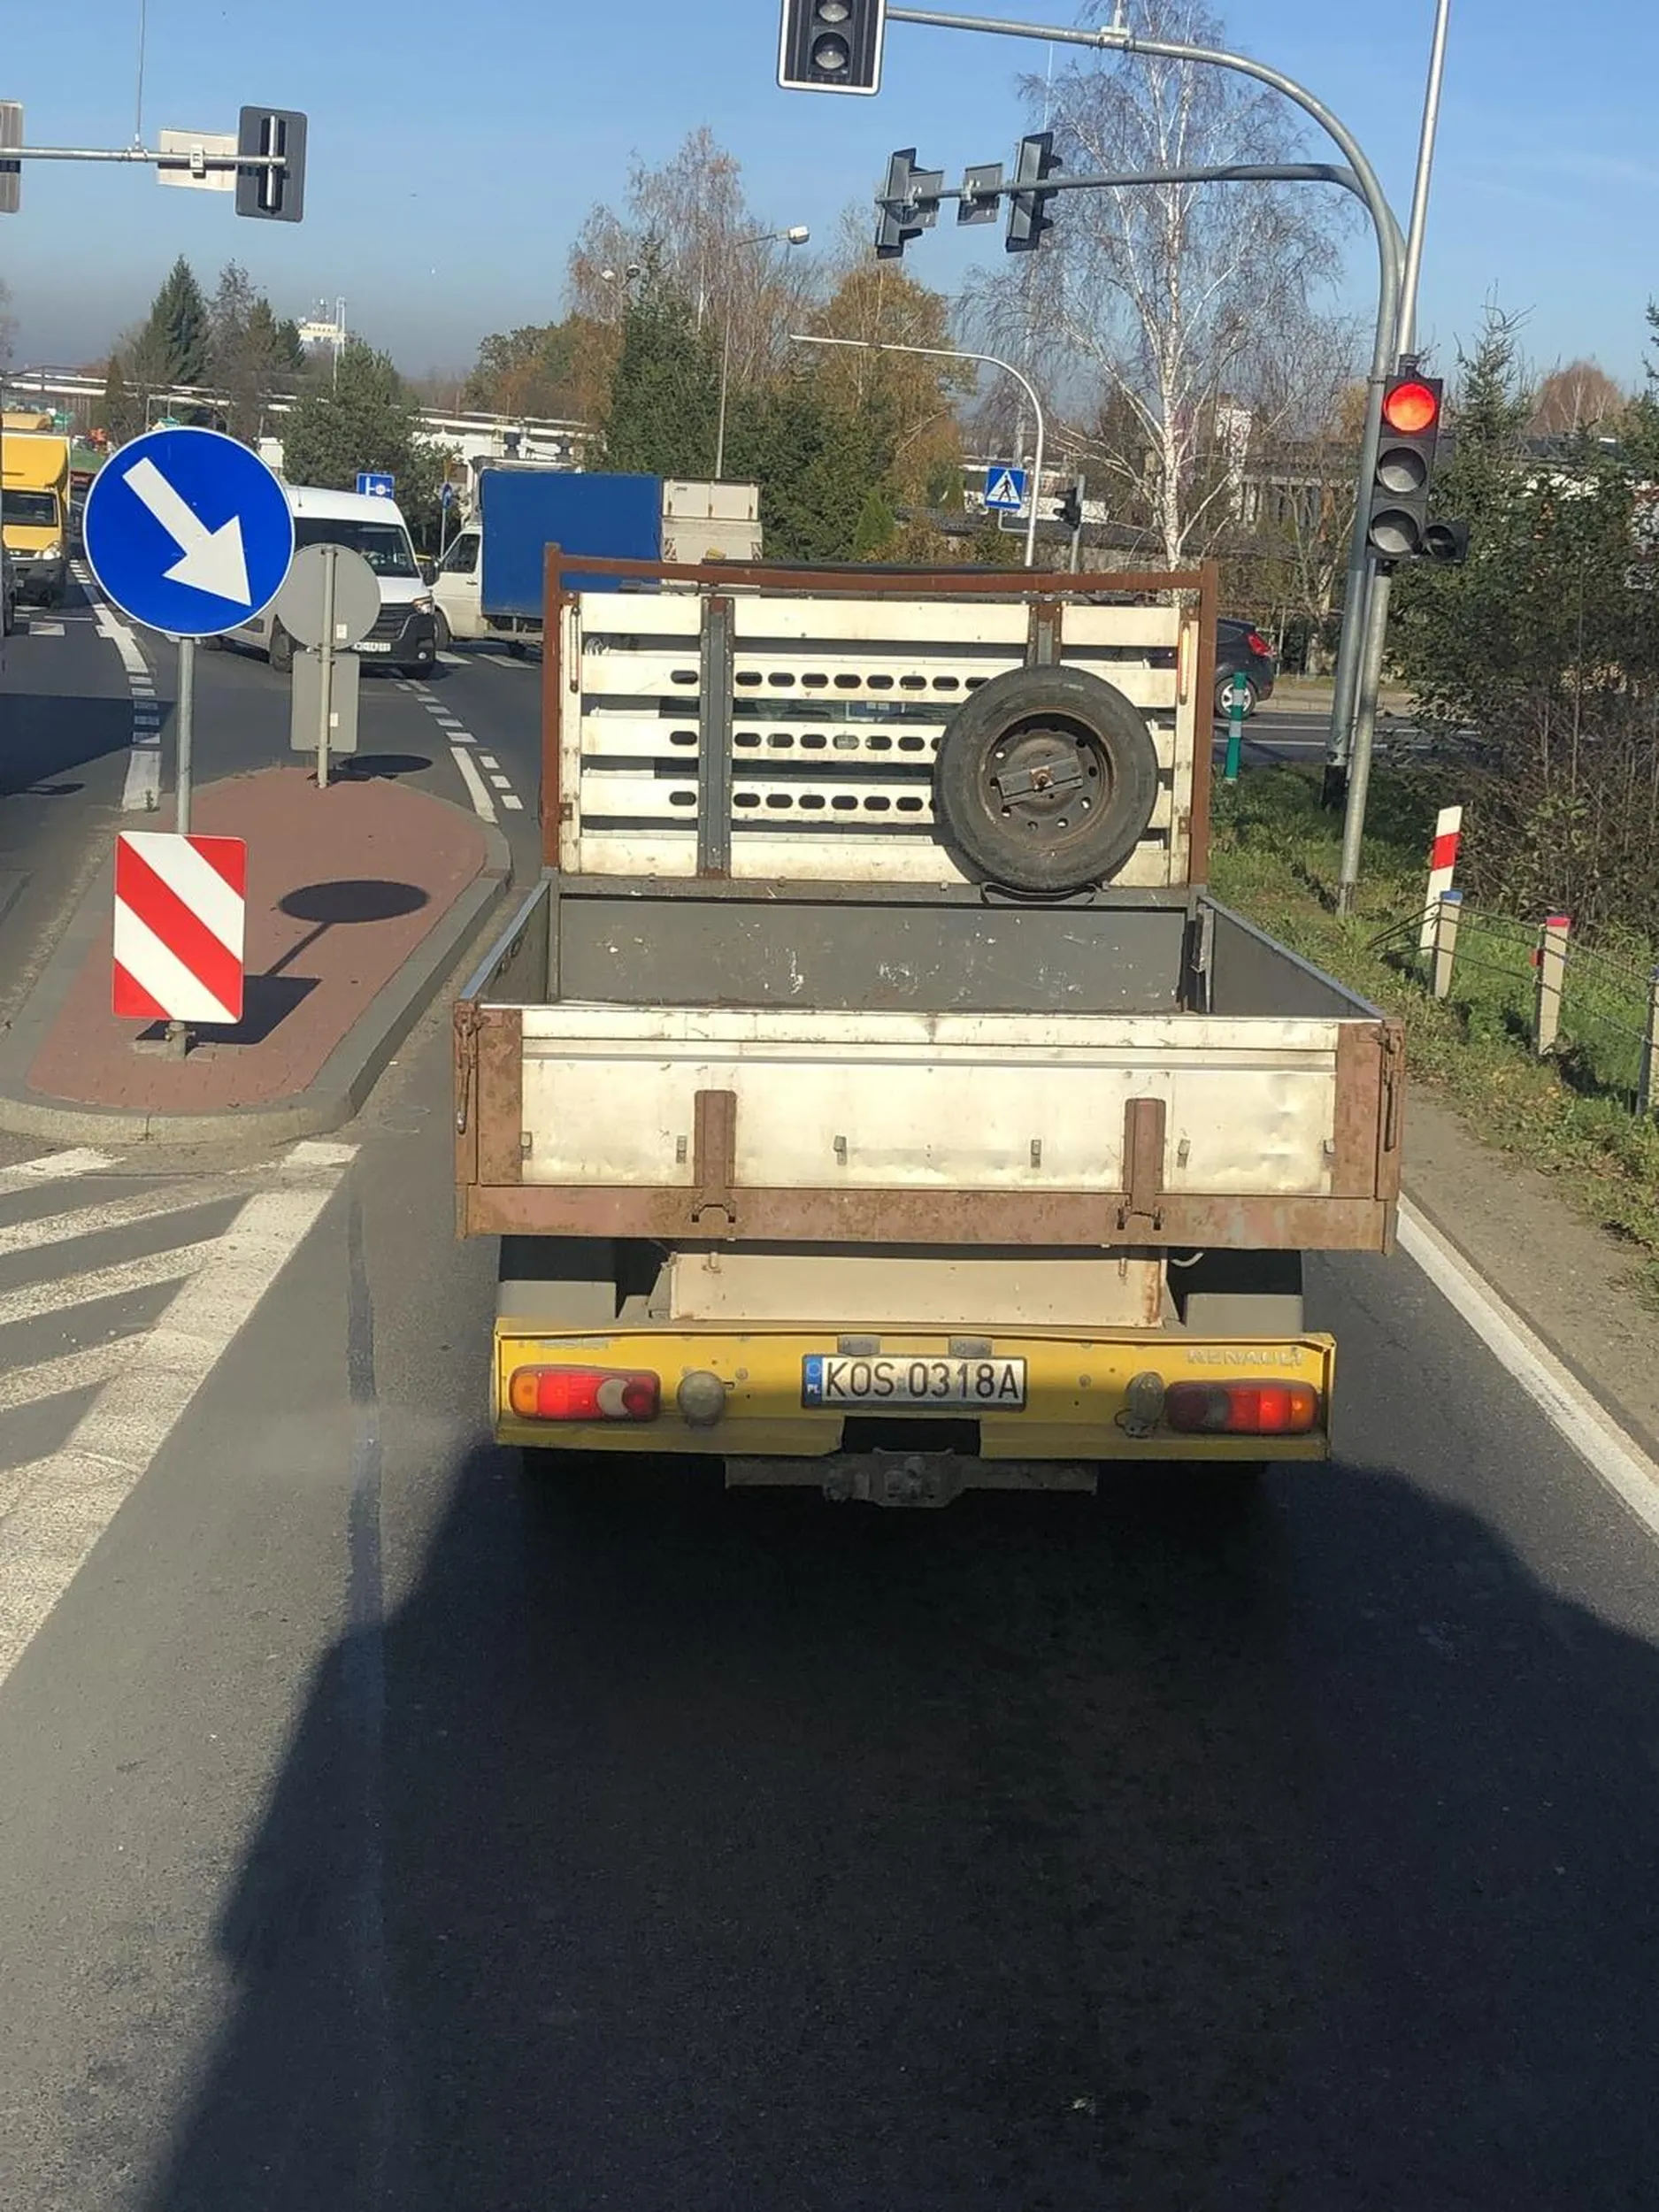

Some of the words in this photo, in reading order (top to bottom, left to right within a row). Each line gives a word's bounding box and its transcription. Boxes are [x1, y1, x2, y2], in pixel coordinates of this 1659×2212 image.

[1187, 1348, 1302, 1367] RENAULT
[807, 1384, 820, 1394] PL
[826, 1363, 895, 1396] KOS
[908, 1363, 1018, 1398] 0318A
